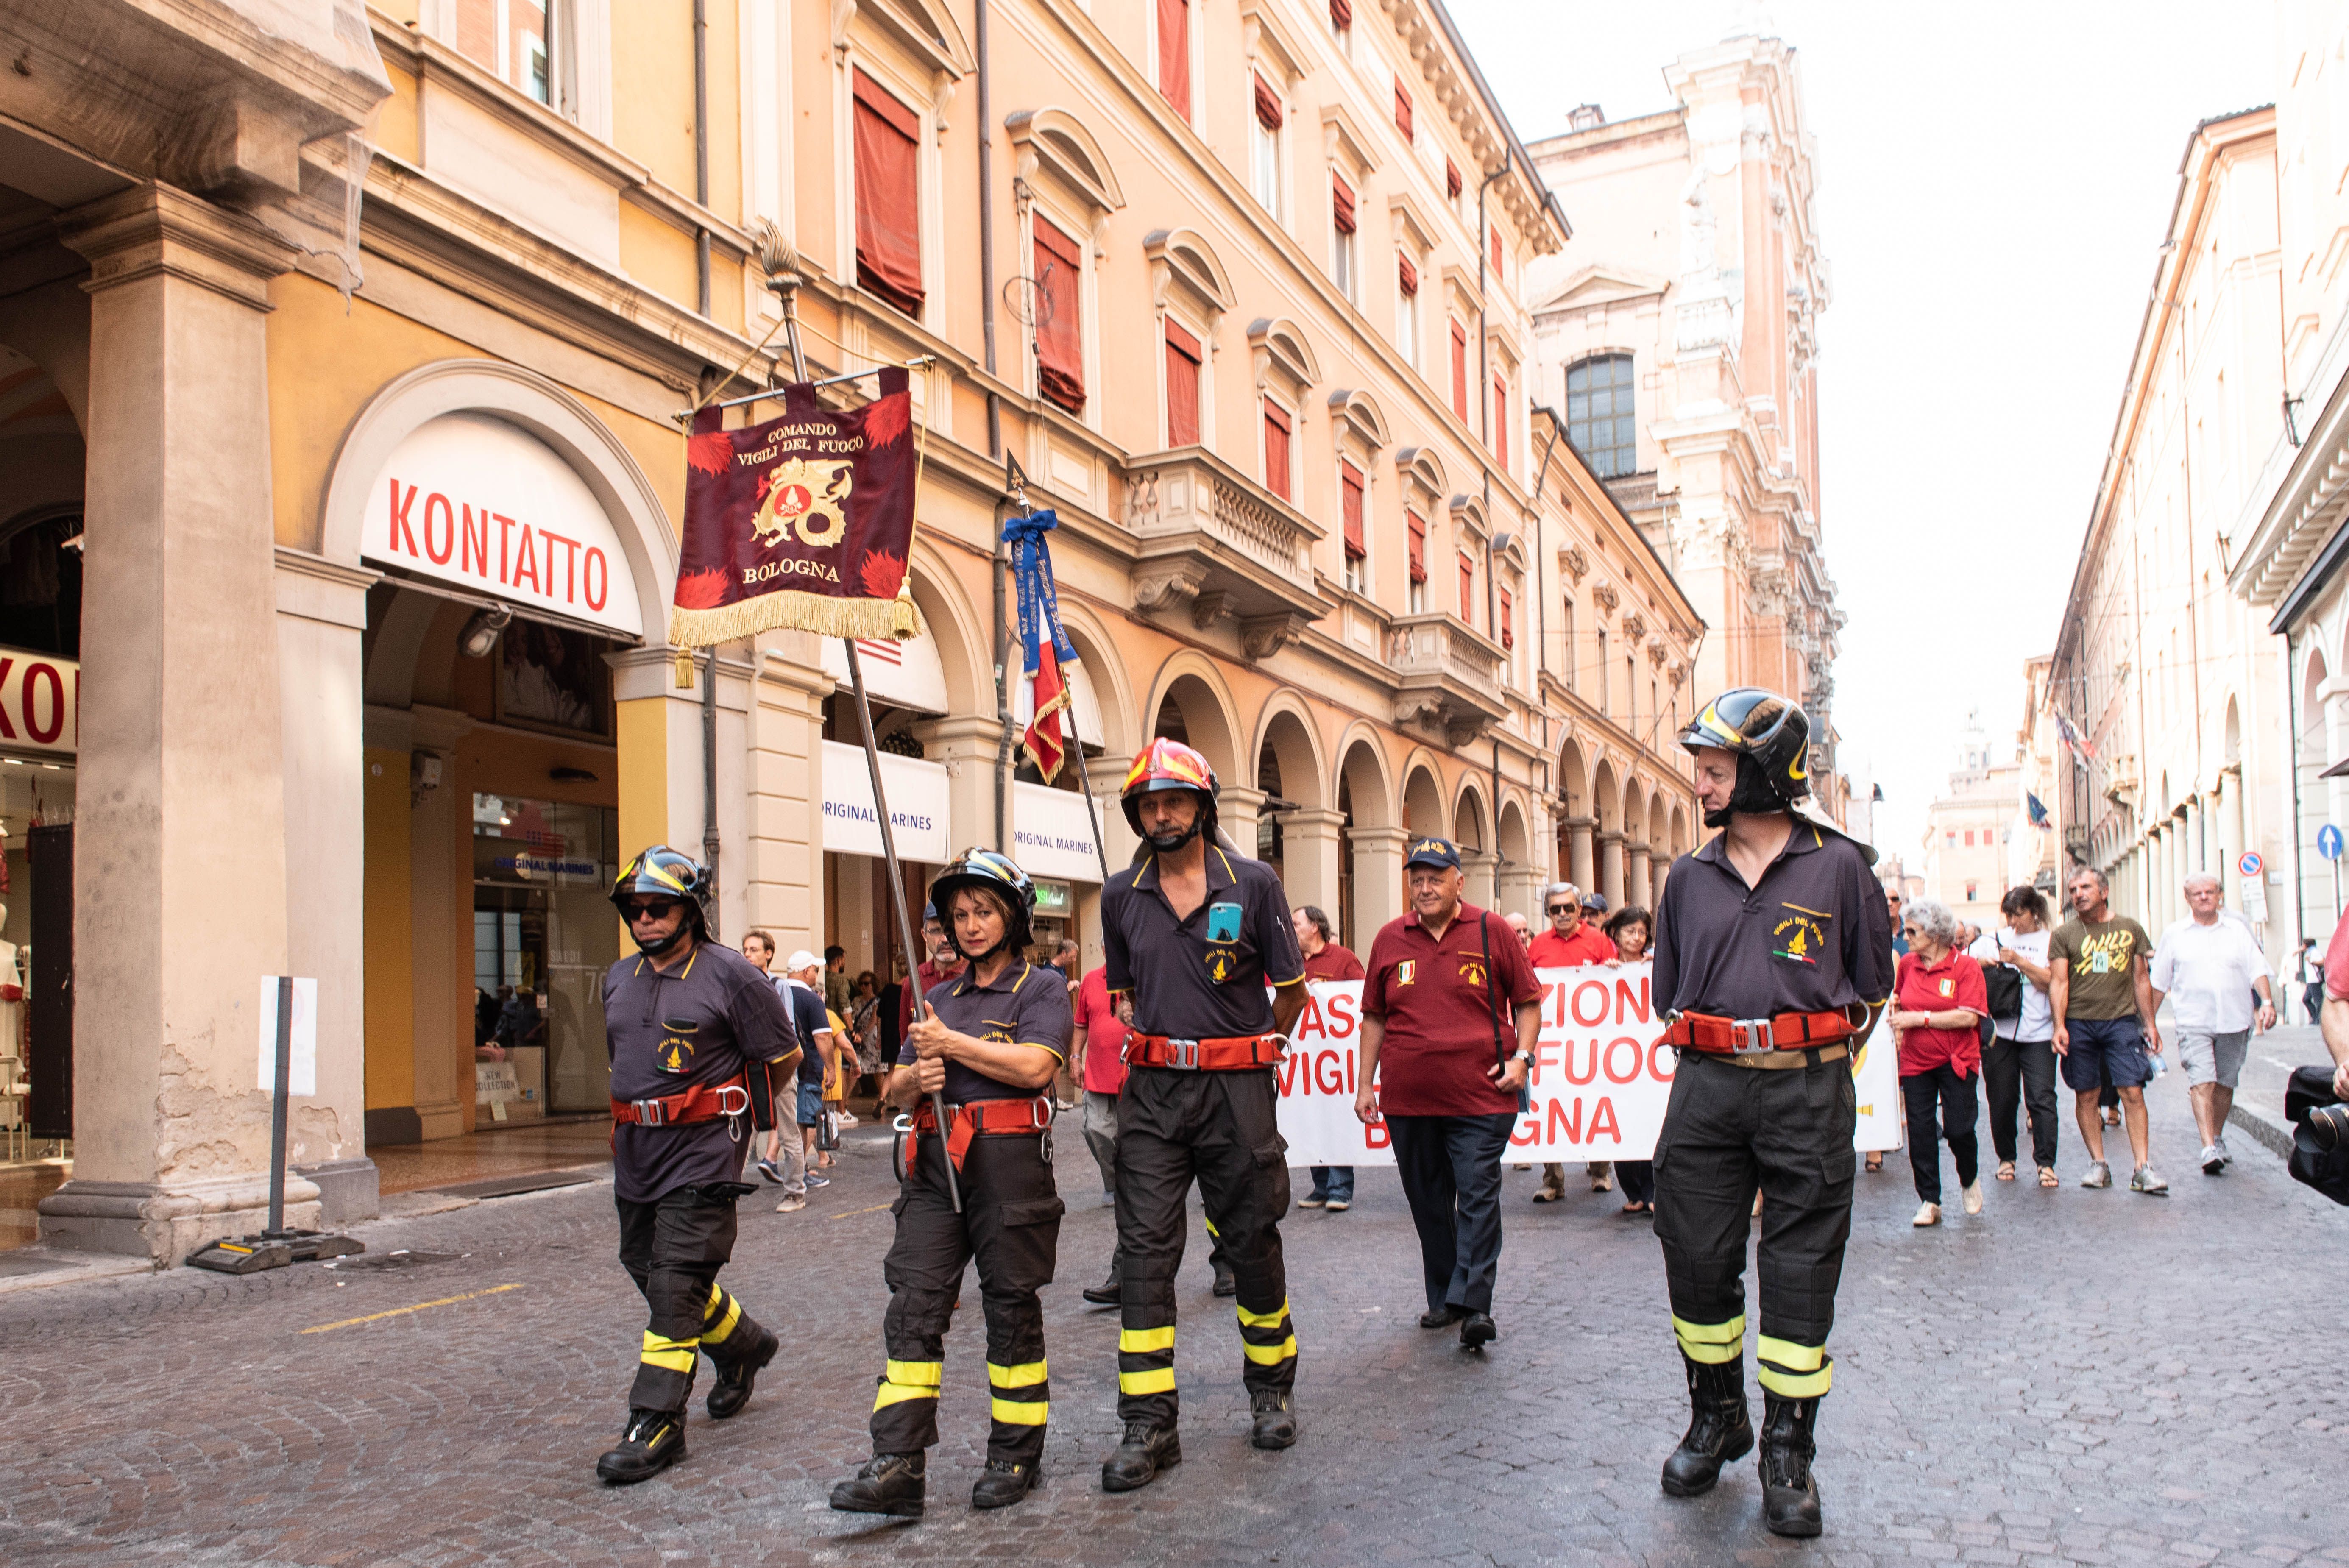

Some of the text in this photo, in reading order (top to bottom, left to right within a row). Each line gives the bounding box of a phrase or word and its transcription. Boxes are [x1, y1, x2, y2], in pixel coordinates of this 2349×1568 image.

[768, 423, 837, 444] COMANDO
[737, 436, 864, 466] VIGILI DEL FUOCO
[389, 478, 608, 612] KONTATTO
[742, 557, 841, 584] BOLOGNA
[1051, 610, 1069, 651] BOLOGNA
[822, 801, 932, 831] RIGINAL ARINES
[1056, 838, 1092, 855] MARINES
[495, 857, 594, 875] ORIGINAL MARINES
[1774, 916, 1824, 947] VIGILI DEL FUOCO
[2081, 929, 2133, 958] WILD
